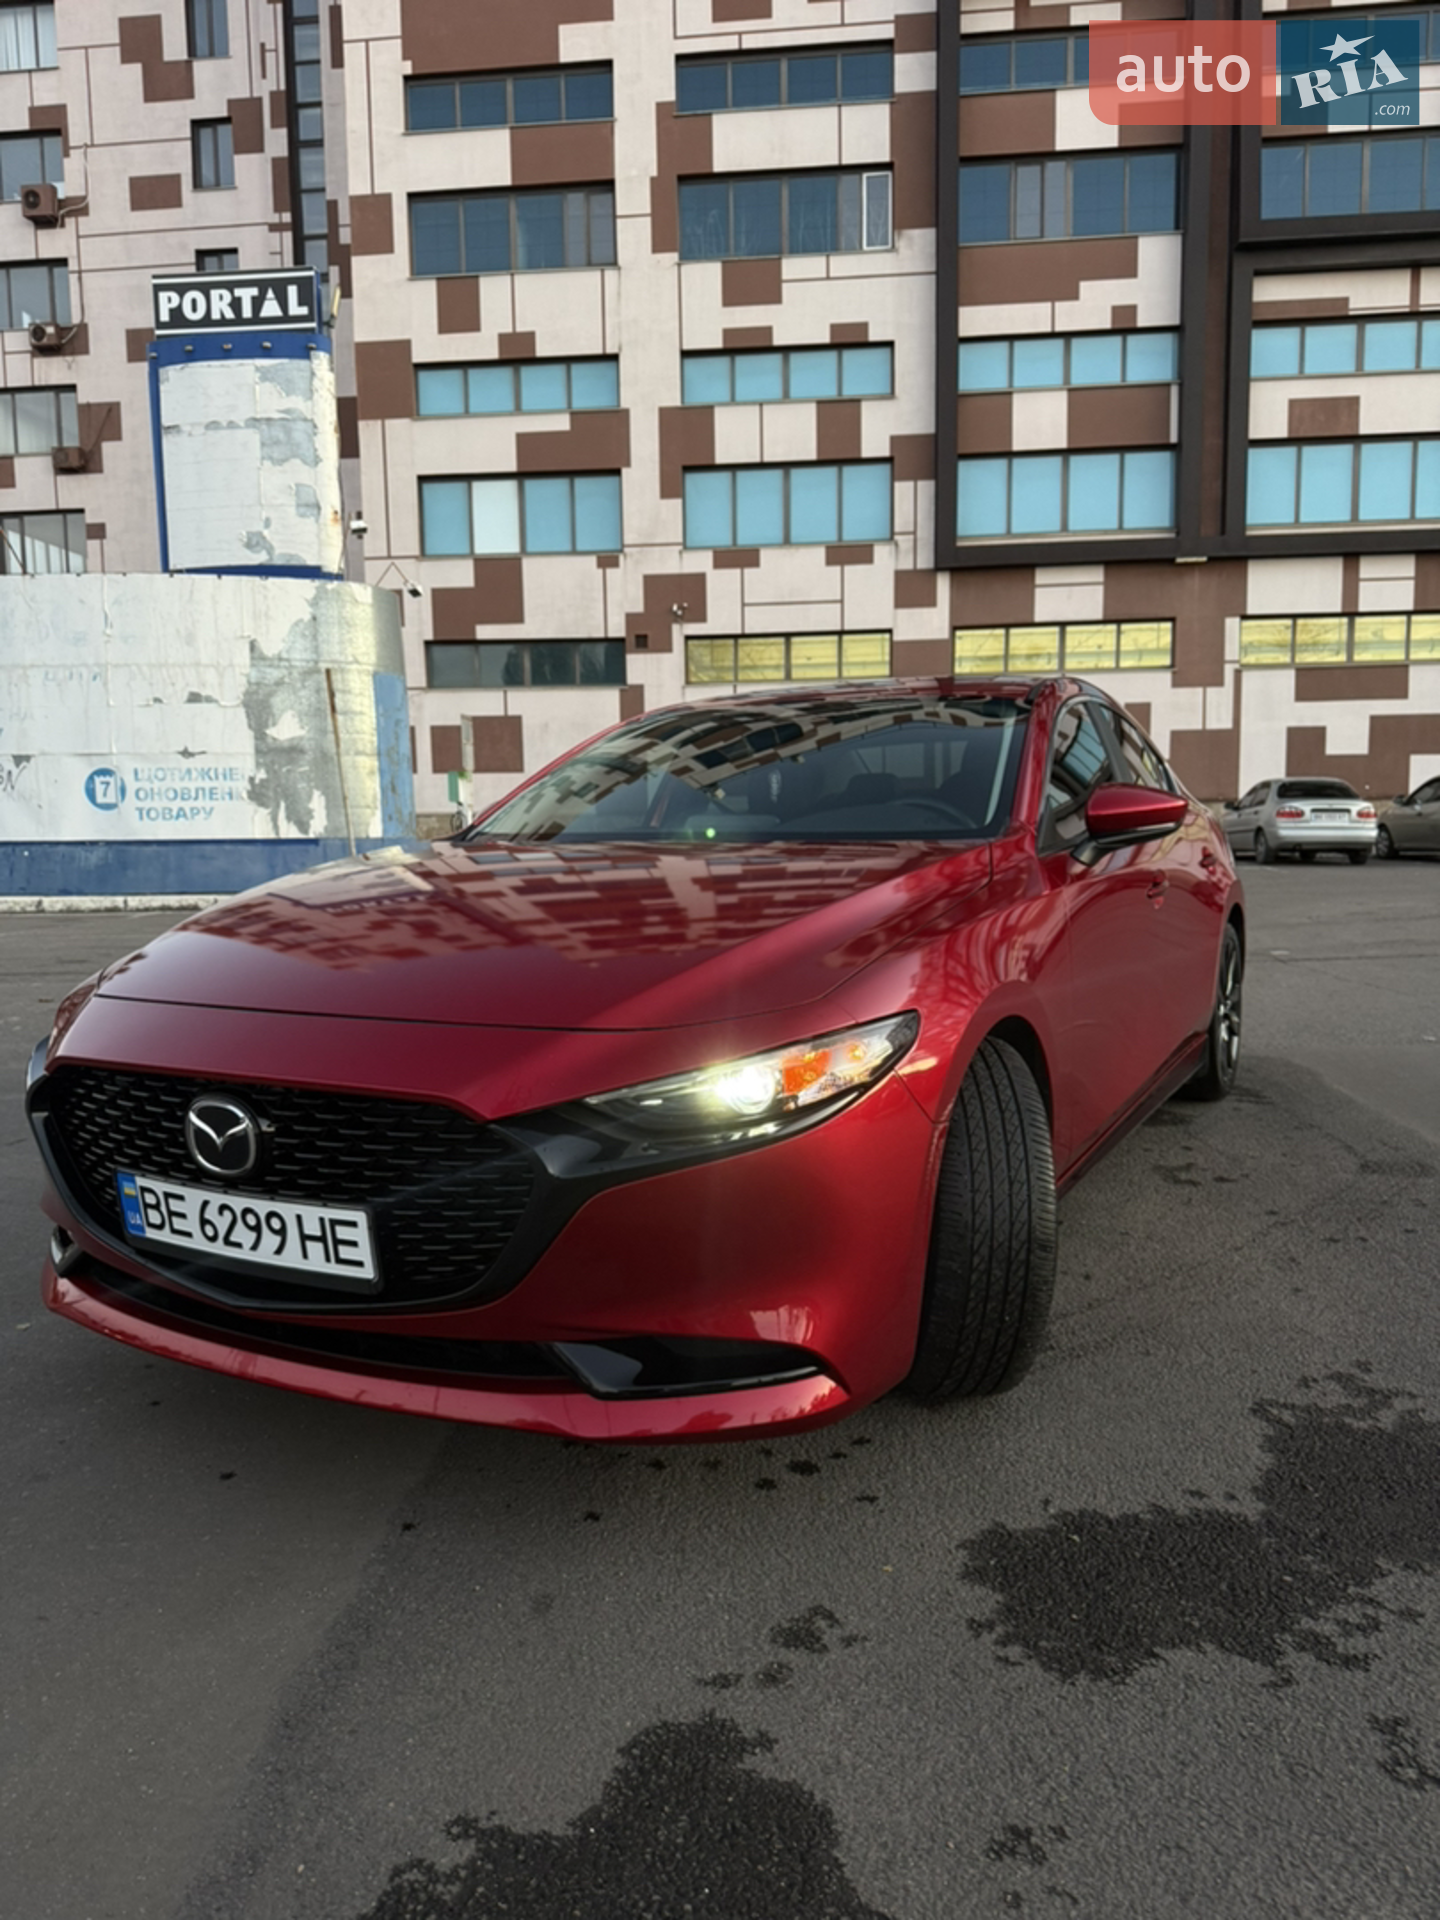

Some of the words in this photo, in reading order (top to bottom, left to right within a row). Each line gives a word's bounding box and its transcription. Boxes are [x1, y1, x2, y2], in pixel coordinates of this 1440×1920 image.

[158, 285, 309, 322] PORTAL
[134, 767, 245, 784] ЩОТИЖНЕ
[100, 781, 111, 798] 7
[136, 807, 214, 821] ТОВАРУ
[128, 1211, 143, 1225] UA
[139, 1185, 193, 1239] BE
[199, 1200, 288, 1255] 6299
[295, 1213, 365, 1268] HE
